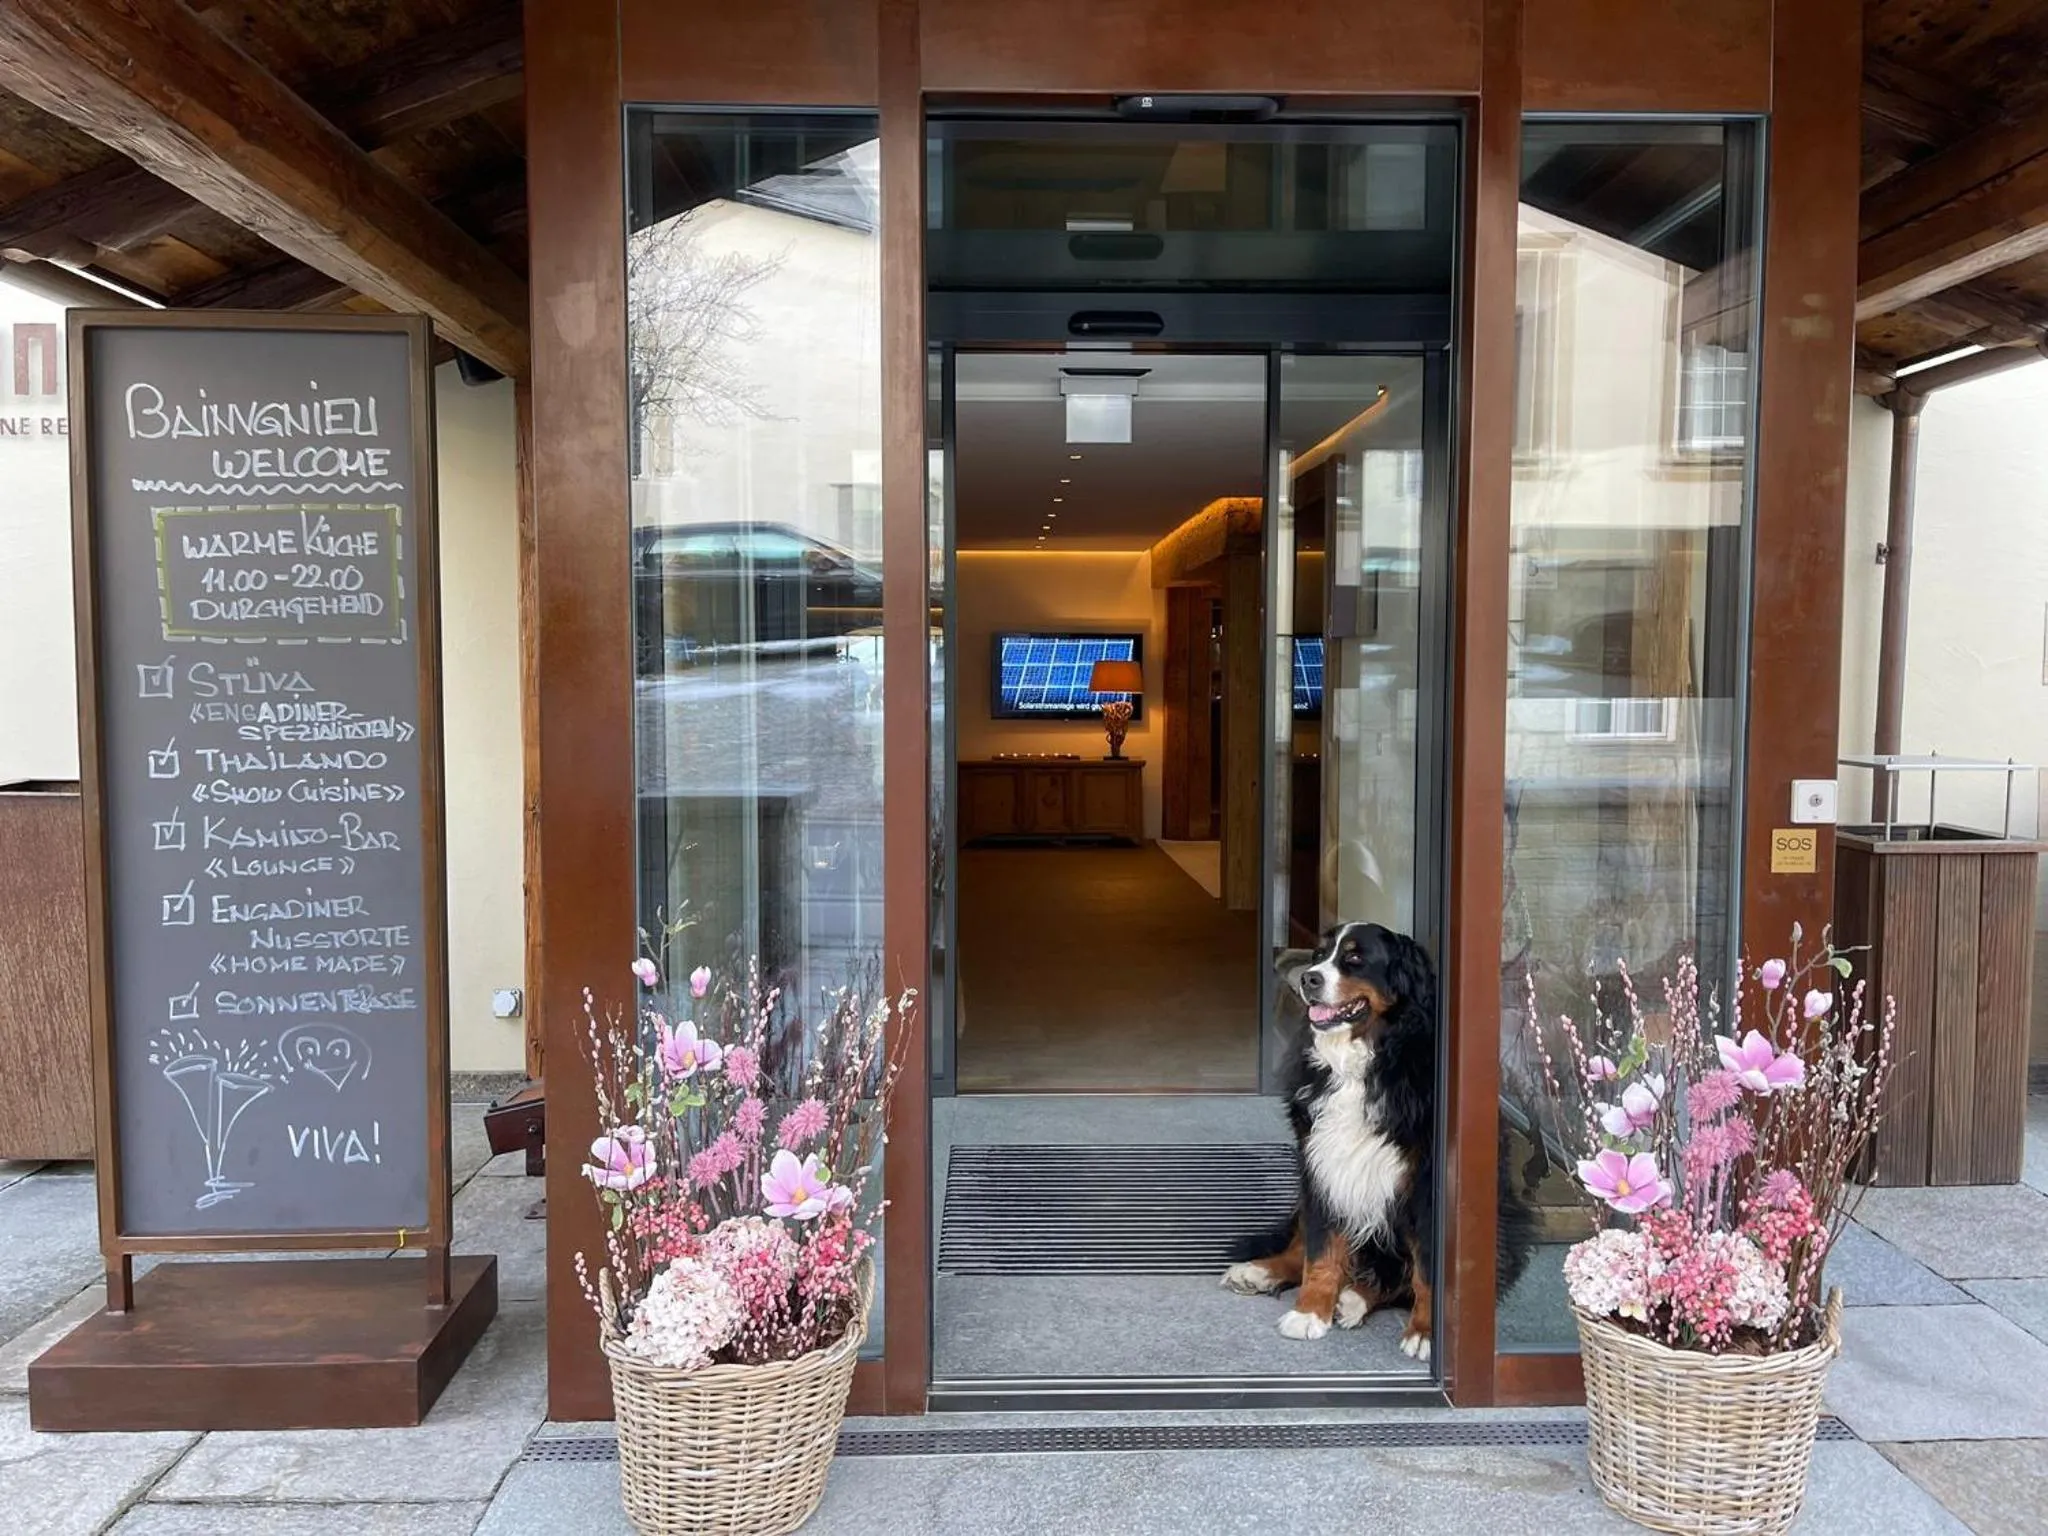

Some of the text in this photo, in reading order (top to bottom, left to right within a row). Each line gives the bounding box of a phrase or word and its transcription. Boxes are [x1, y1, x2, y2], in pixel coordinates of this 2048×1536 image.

[212, 447, 391, 478] WELCOME
[182, 529, 298, 559] WARME
[190, 592, 384, 624] DURCHGEHEND
[195, 745, 387, 774] THAILANDO
[1776, 837, 1812, 850] SOS
[211, 887, 370, 923] ENGADINER
[250, 926, 411, 950] NUSSTORTE
[287, 1119, 381, 1165] VIVA!
